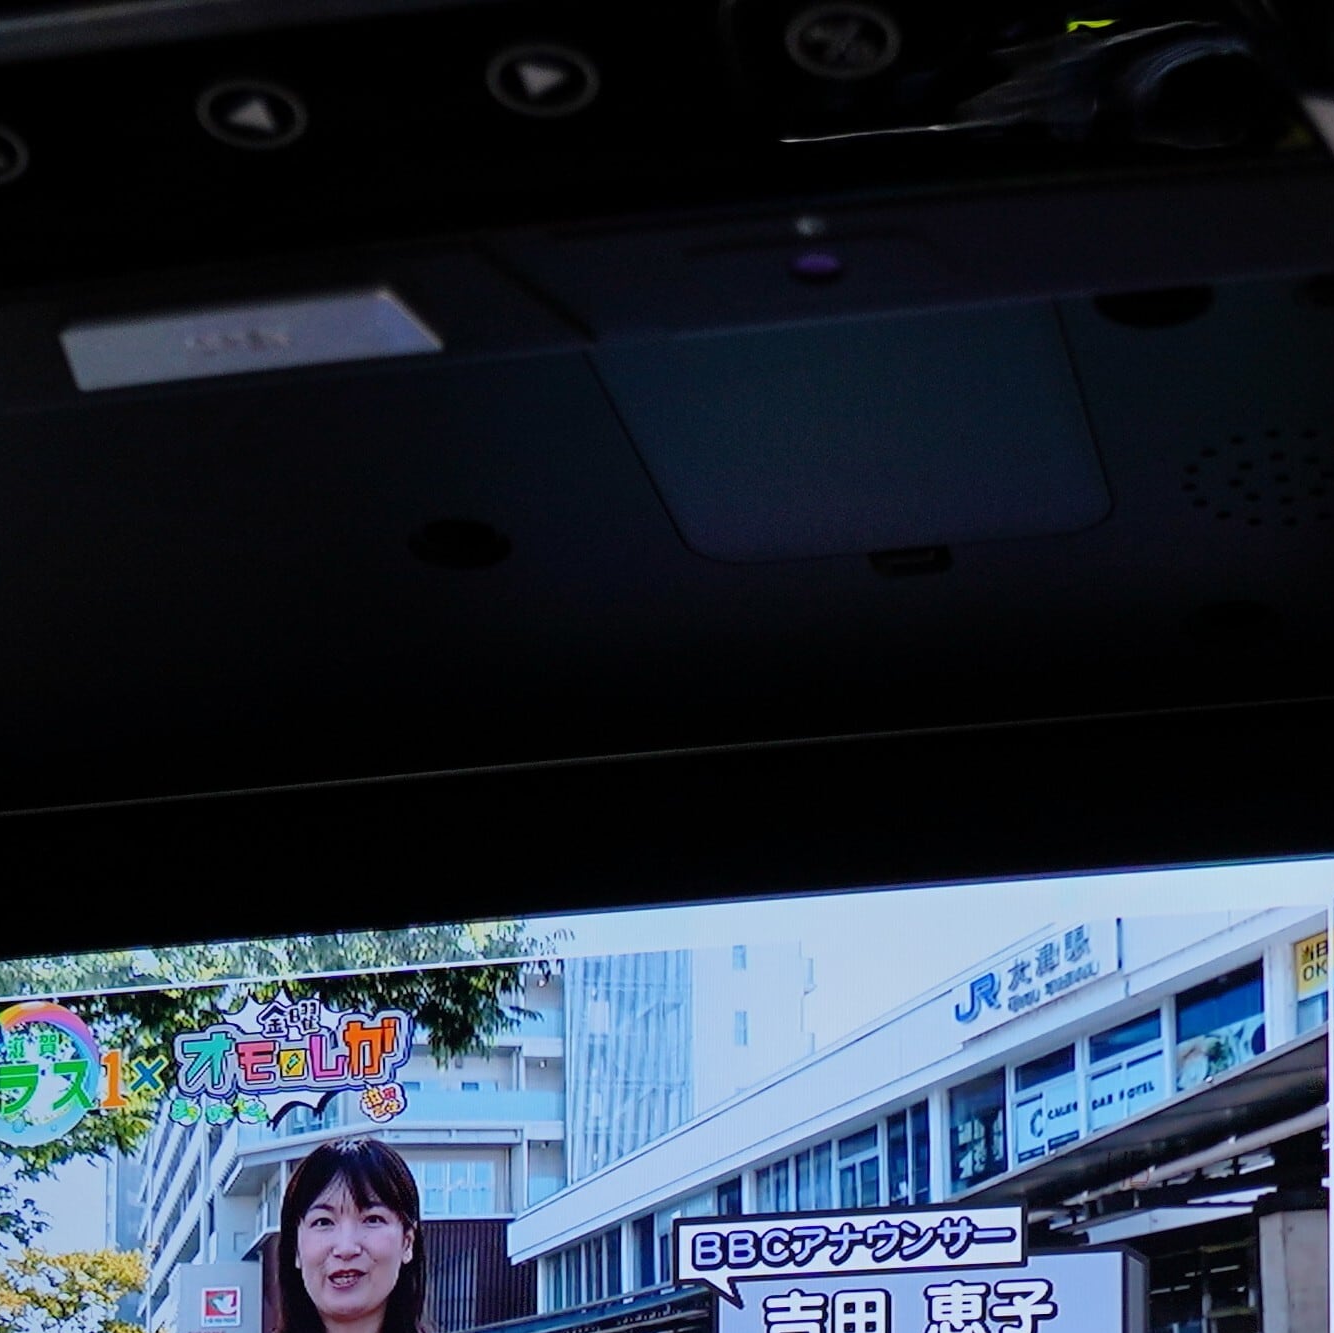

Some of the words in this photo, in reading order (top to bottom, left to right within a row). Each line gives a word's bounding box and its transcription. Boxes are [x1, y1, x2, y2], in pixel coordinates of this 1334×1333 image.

[259, 1001, 320, 1035] 金曜
[955, 972, 1002, 1024] JR
[691, 1217, 1017, 1271] BBCアナウンサー
